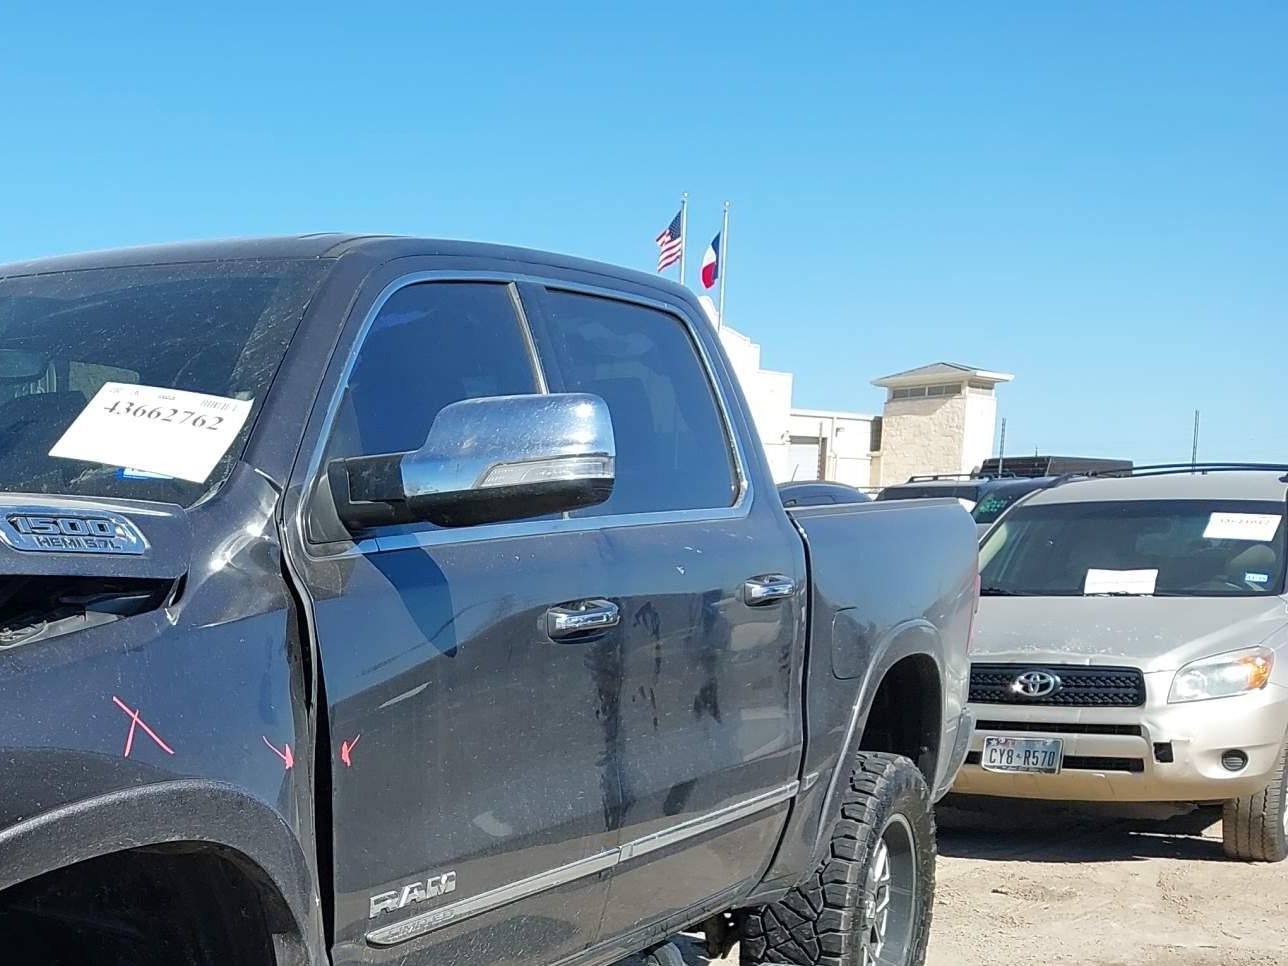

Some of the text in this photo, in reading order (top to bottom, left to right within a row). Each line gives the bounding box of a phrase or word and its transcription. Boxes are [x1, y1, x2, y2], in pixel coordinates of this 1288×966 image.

[104, 400, 224, 431] 43662762
[9, 515, 116, 536] 1500
[34, 536, 83, 548] HEMI
[369, 870, 457, 920] RAM
